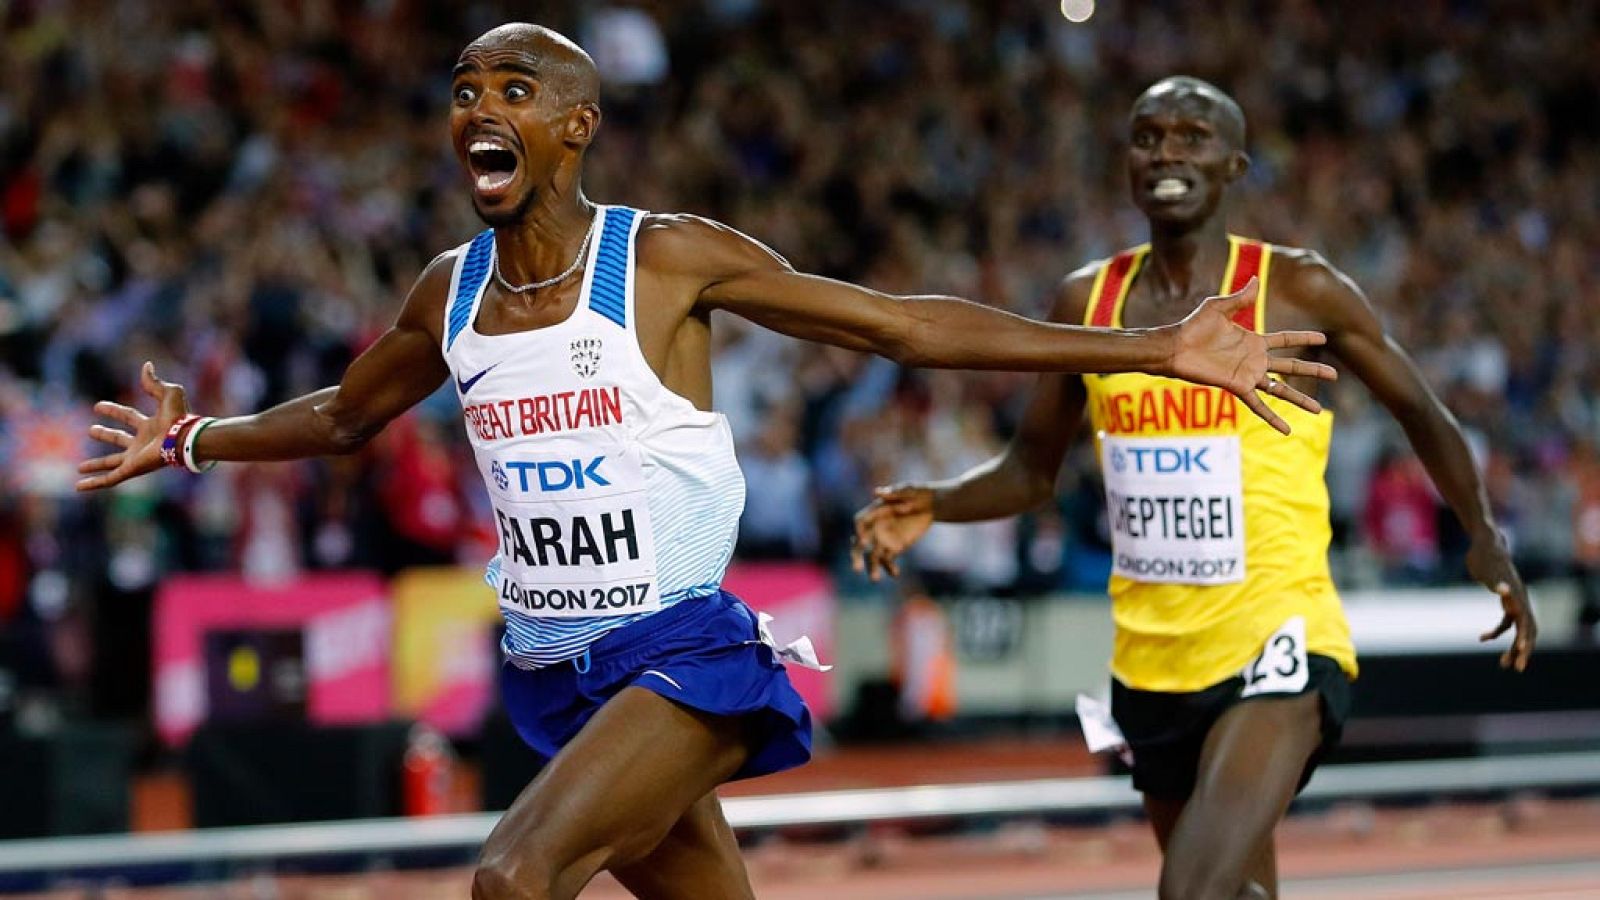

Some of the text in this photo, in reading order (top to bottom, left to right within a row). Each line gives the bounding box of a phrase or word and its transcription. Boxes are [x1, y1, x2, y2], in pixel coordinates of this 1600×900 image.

[518, 386, 623, 436] BRITAIN
[506, 456, 611, 492] TDK
[1127, 446, 1210, 474] TDK
[1110, 491, 1233, 540] HEPTEGEI
[497, 508, 640, 567] FARAH
[1117, 554, 1238, 578] ONDON 2017
[502, 578, 650, 610] LONDON 2017
